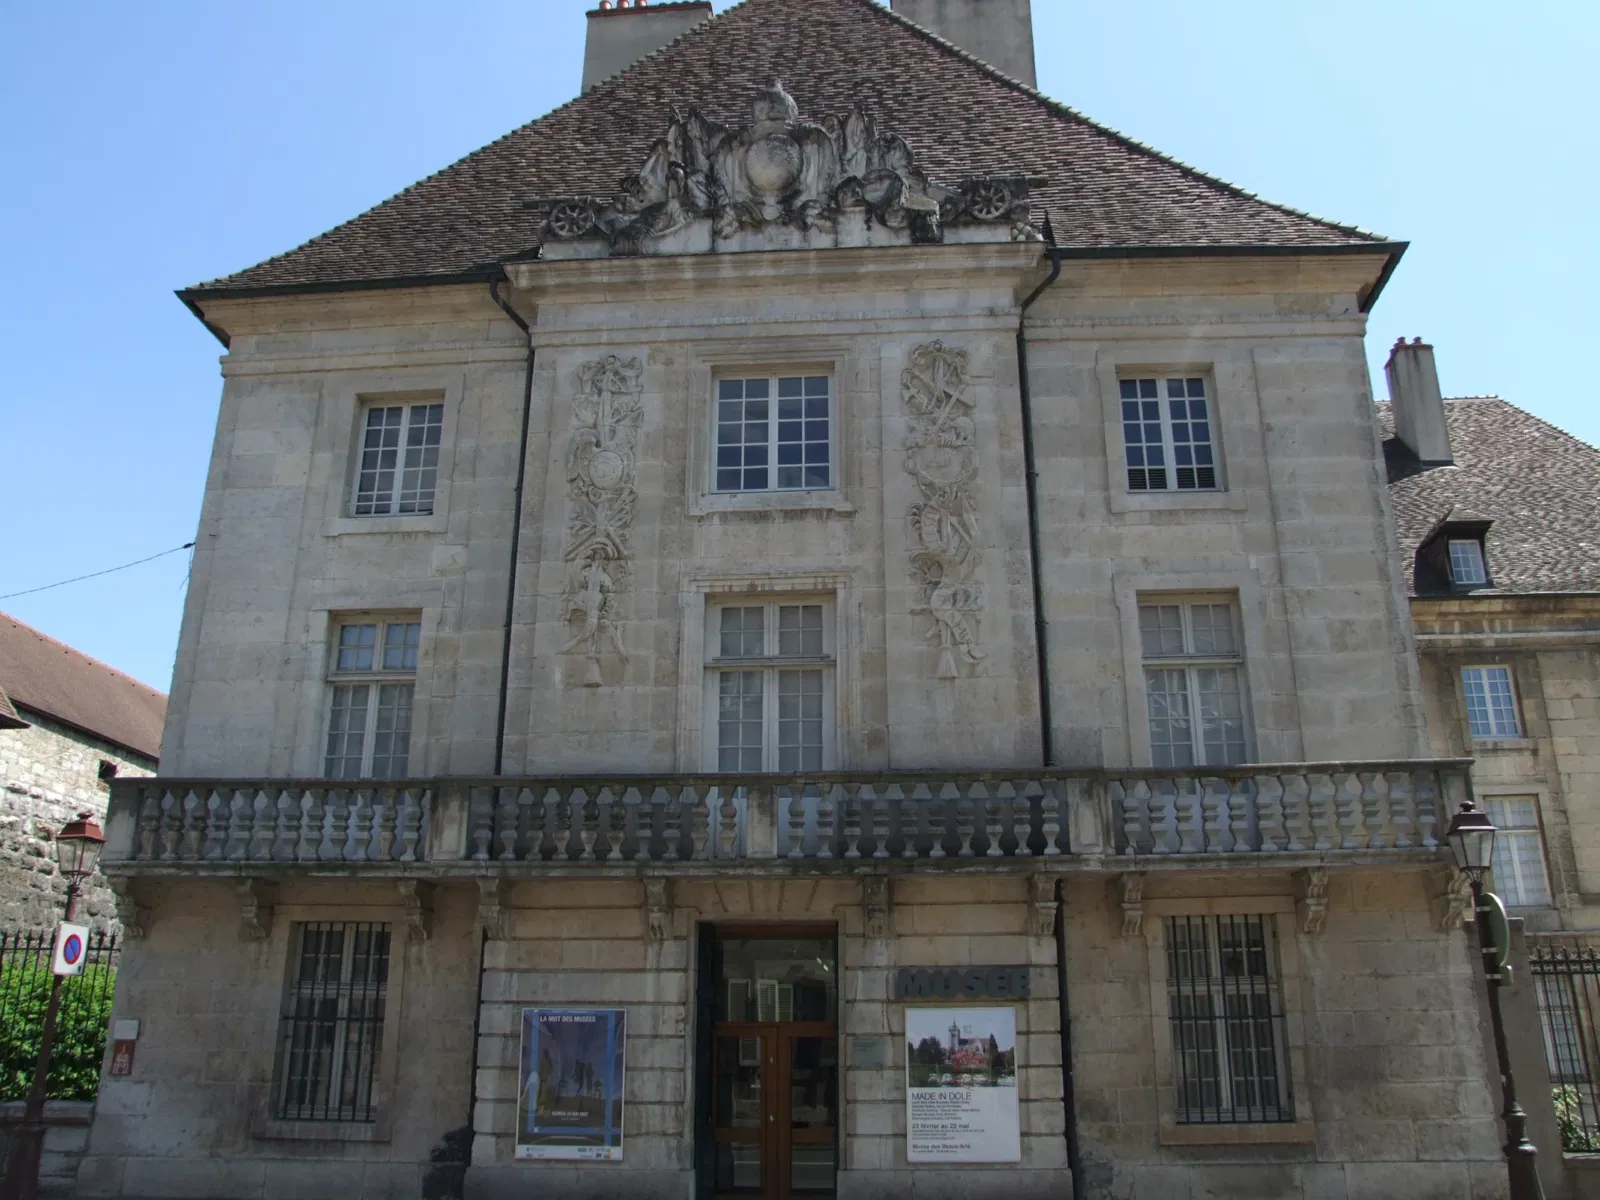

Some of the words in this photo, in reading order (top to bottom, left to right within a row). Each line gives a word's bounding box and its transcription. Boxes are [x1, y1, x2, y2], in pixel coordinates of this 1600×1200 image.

[912, 1092, 936, 1100] MADE
[939, 1092, 946, 1100] IN
[949, 1092, 972, 1100] DOLE
